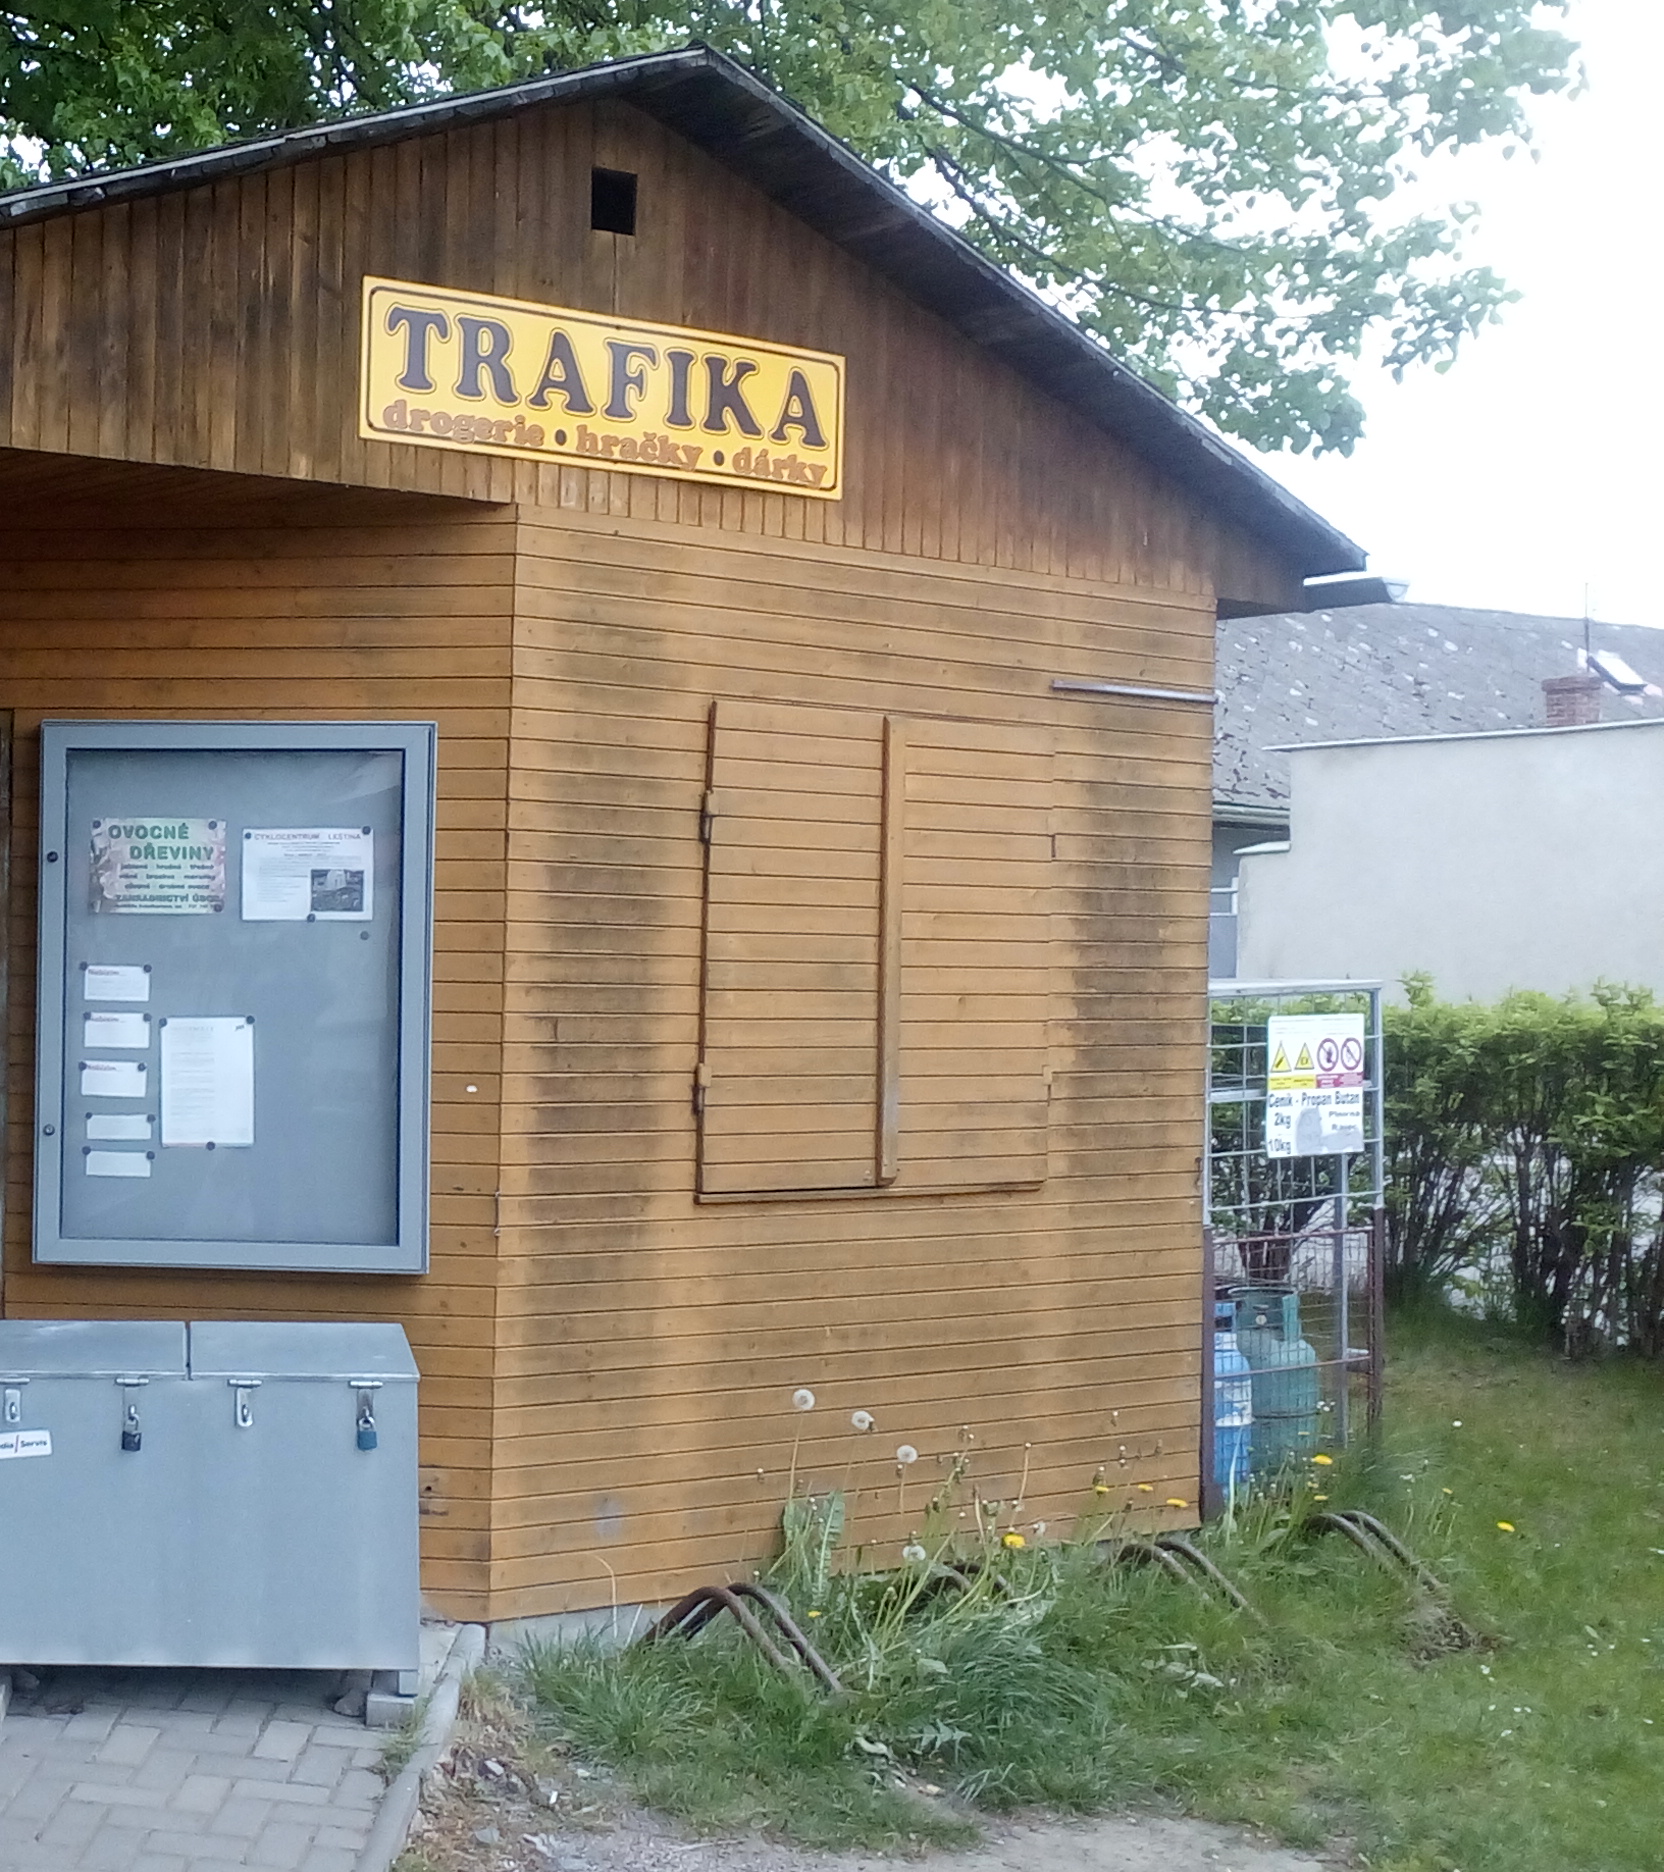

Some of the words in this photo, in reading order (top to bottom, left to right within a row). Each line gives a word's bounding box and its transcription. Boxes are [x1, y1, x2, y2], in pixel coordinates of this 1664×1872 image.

[385, 303, 830, 450] TRAFIKA
[383, 399, 544, 445] drogerie
[577, 423, 703, 473] hračky
[732, 445, 829, 489] dárky
[108, 822, 189, 839] OVOCNÉ
[129, 842, 214, 860] DŘEVINY
[1274, 1112, 1291, 1129] 2kg
[1268, 1138, 1291, 1154] 10kg
